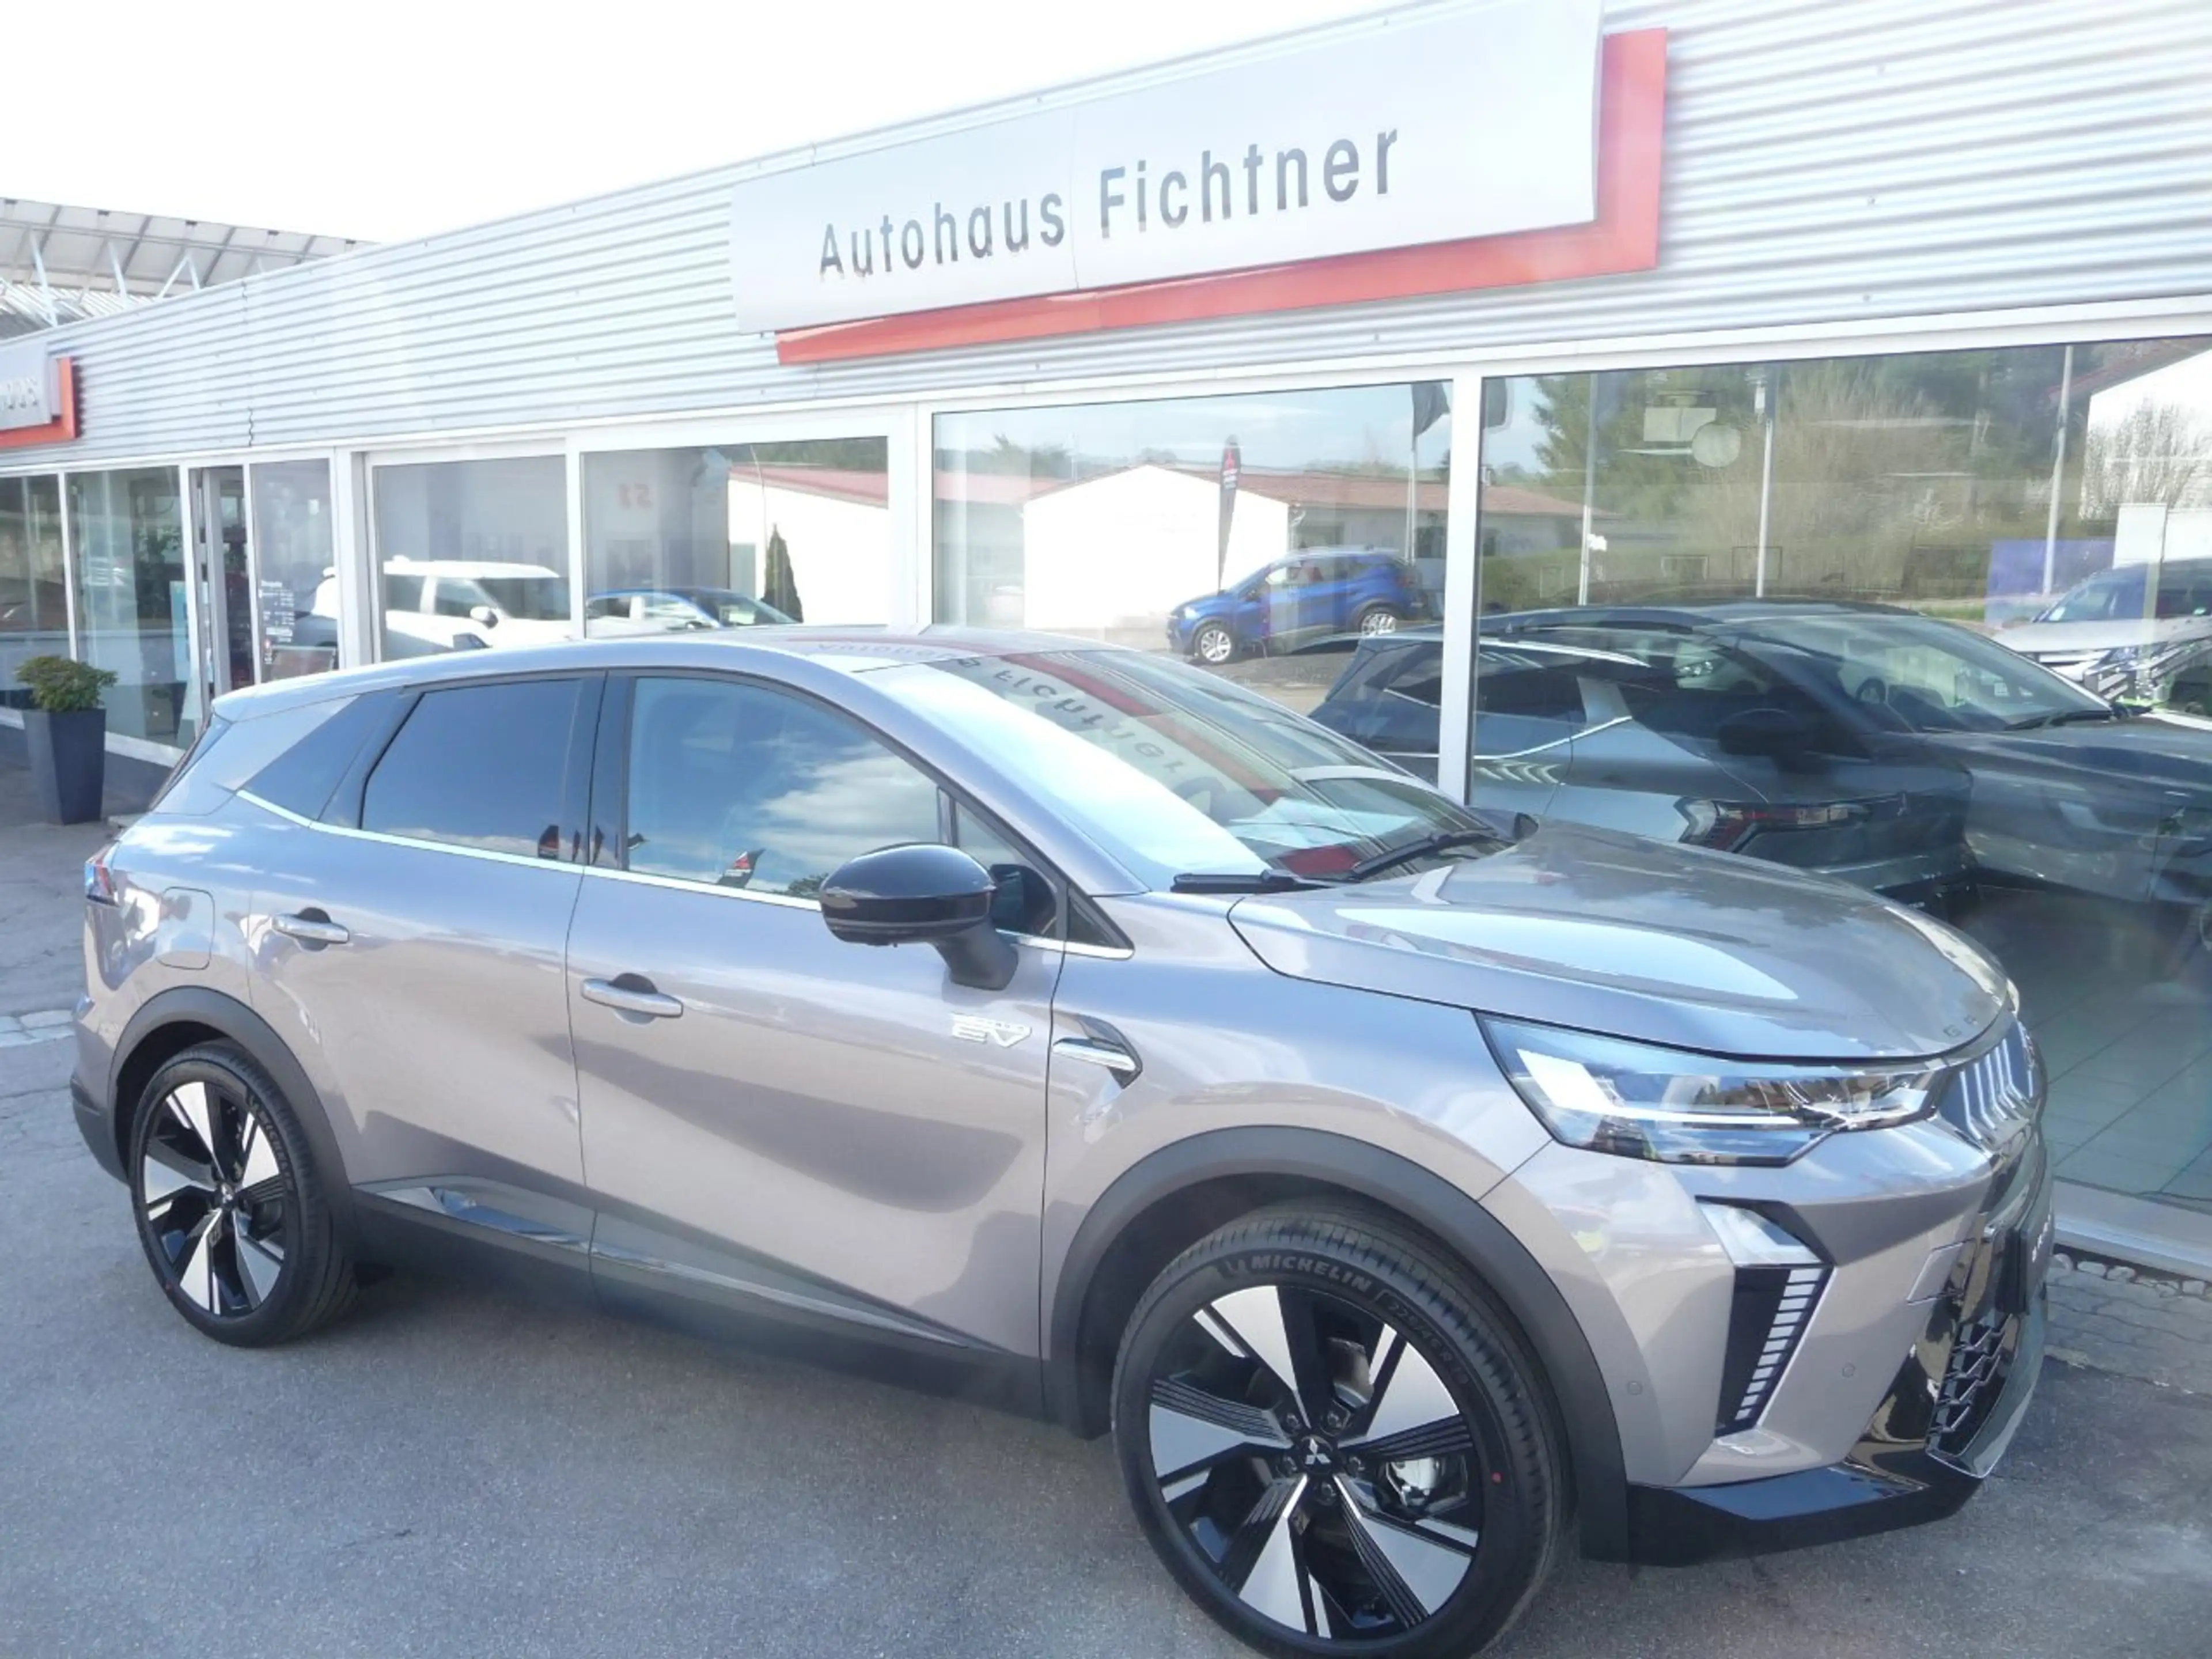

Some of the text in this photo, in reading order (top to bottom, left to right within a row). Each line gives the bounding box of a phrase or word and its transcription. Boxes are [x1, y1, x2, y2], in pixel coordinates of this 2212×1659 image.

[819, 127, 1399, 280] Autohaus Fichtner
[1251, 1255, 1372, 1293] MICHELIN
